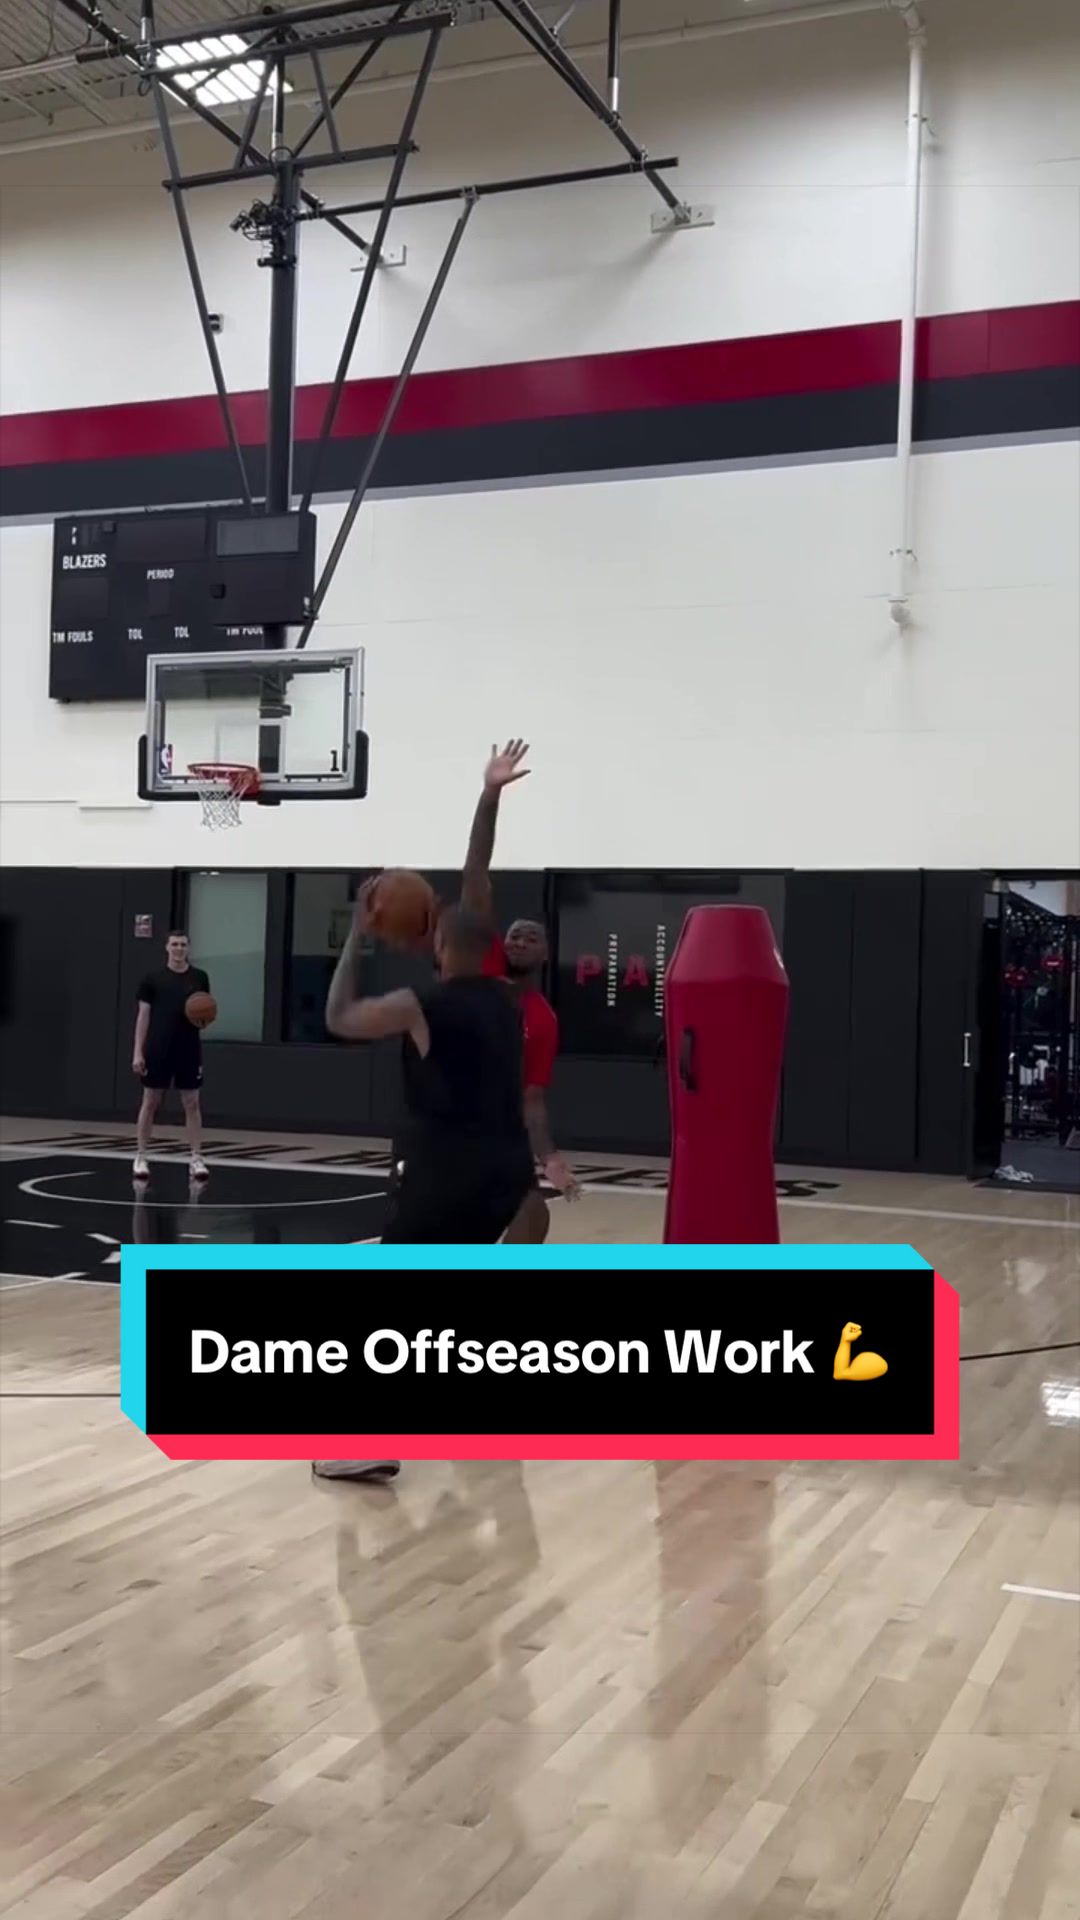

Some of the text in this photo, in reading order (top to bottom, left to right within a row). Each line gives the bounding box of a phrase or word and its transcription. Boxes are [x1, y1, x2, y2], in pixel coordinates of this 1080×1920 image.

[62, 553, 107, 570] BLAZERS
[146, 568, 175, 580] PERIOD
[52, 630, 94, 643] TM FOULS
[128, 628, 143, 640] TOL
[174, 626, 190, 638] TOL
[330, 750, 340, 772] 1
[607, 933, 618, 1007] PREPARATION
[655, 924, 666, 1017] ACCOUNTABILITY
